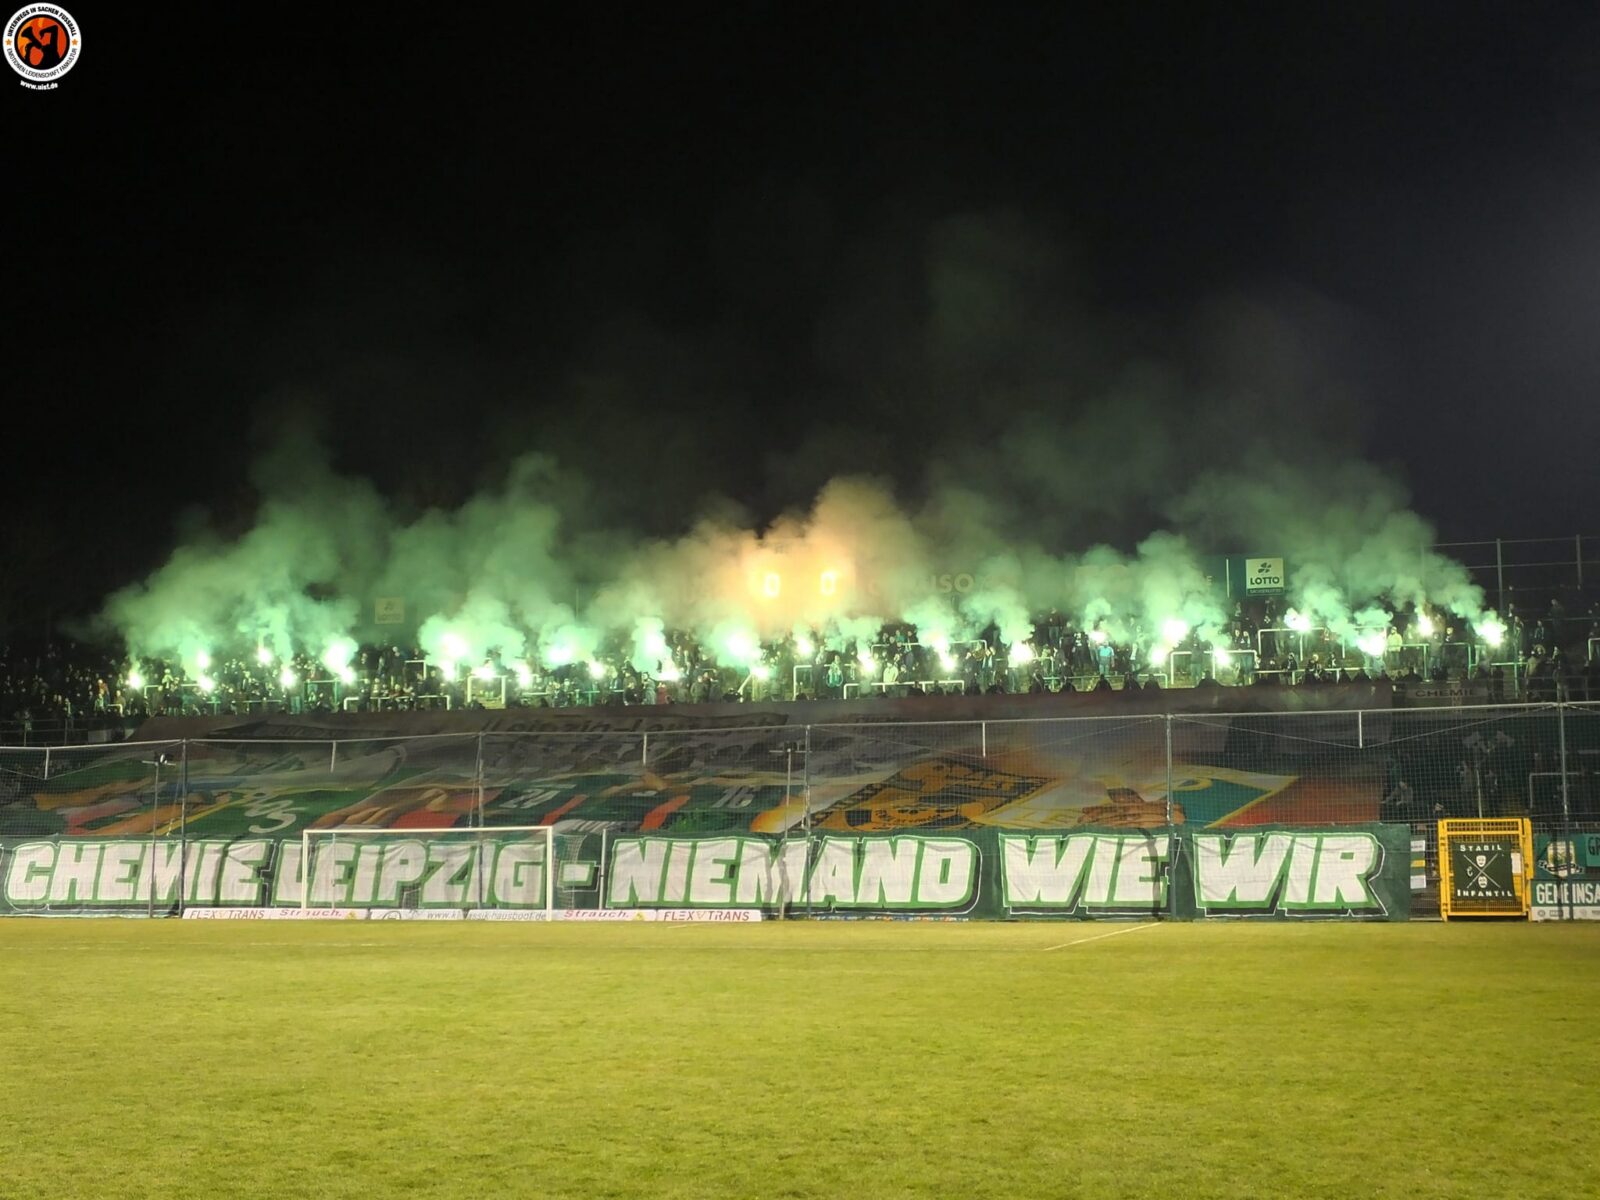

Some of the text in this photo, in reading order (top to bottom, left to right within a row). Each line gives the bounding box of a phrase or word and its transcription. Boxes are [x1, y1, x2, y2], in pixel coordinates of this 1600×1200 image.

[1250, 576, 1280, 585] LOTTO
[1460, 844, 1502, 852] STABIL
[7, 842, 267, 902] CHEMIE
[275, 841, 547, 903] LEIPZIG
[610, 838, 976, 903] NIEMAND
[1003, 836, 1170, 903] WIE
[1197, 835, 1375, 903] WIR
[1457, 889, 1512, 897] INFANTIL
[709, 911, 750, 921] TRANS
